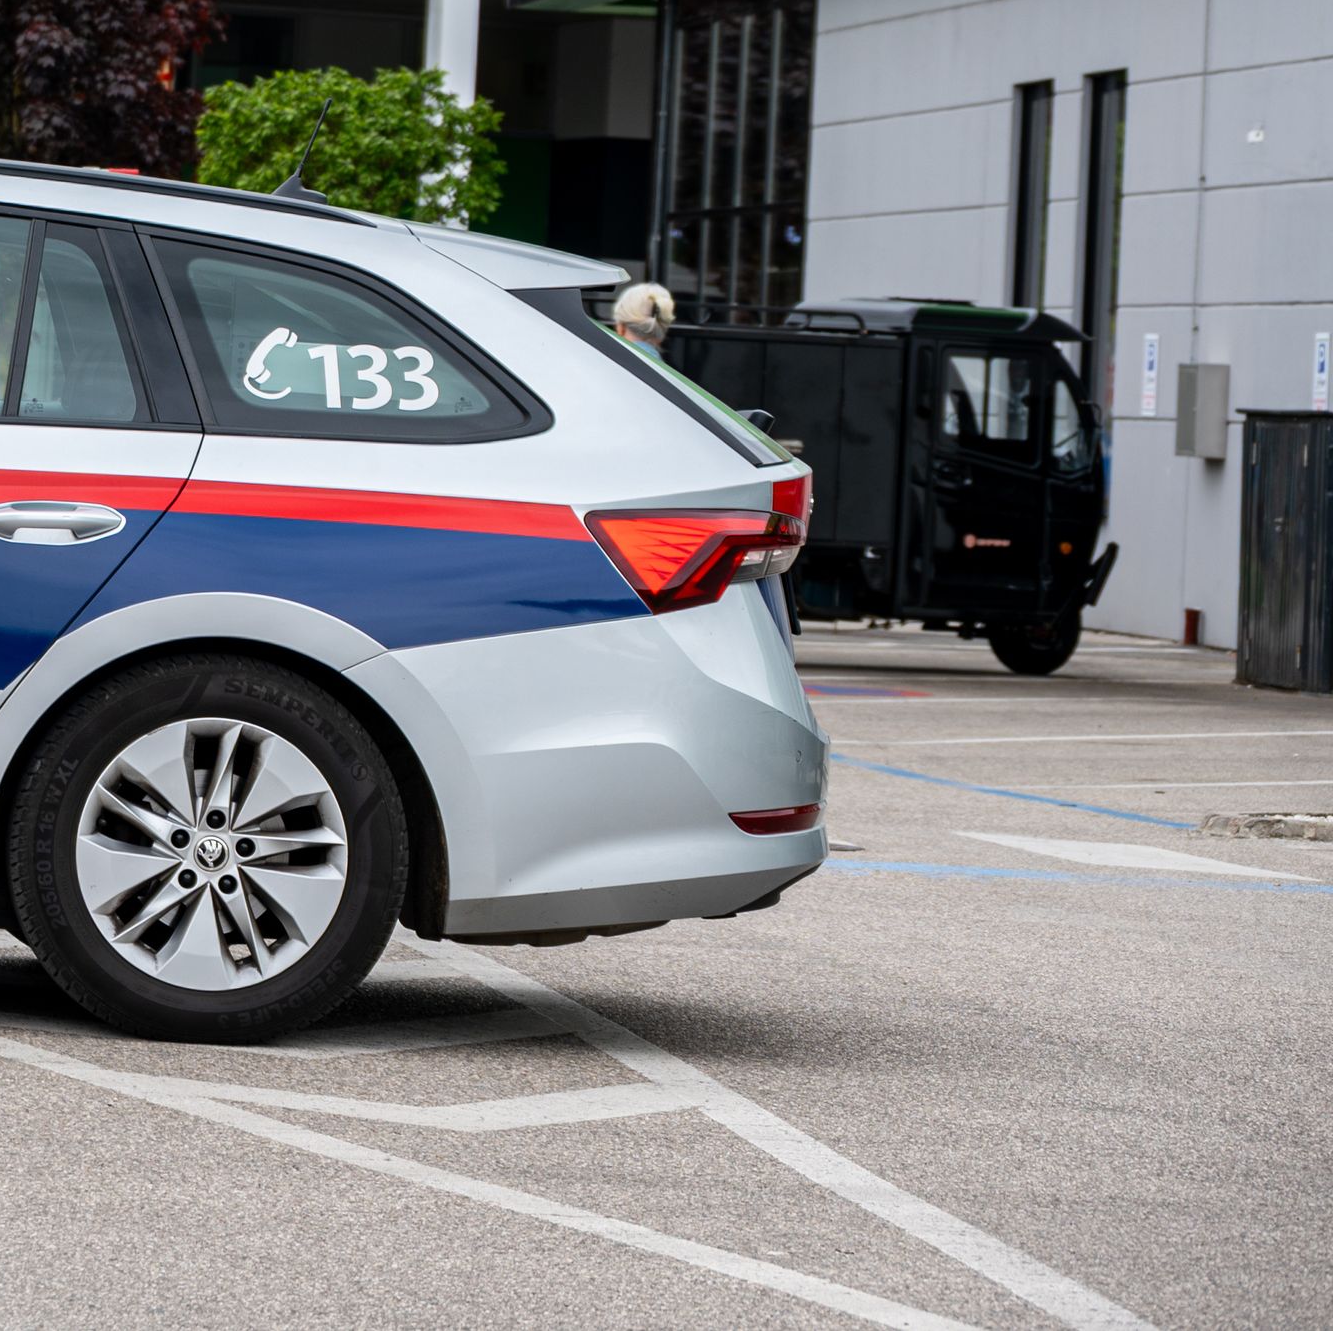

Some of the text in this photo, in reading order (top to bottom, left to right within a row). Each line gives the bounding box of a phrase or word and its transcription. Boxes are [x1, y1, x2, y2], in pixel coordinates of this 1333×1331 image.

[307, 344, 440, 411] 133
[224, 676, 359, 760] SEMPERIT
[53, 756, 81, 785] XL
[36, 812, 55, 833] 16
[35, 839, 54, 856] R
[35, 857, 68, 930] 205/60
